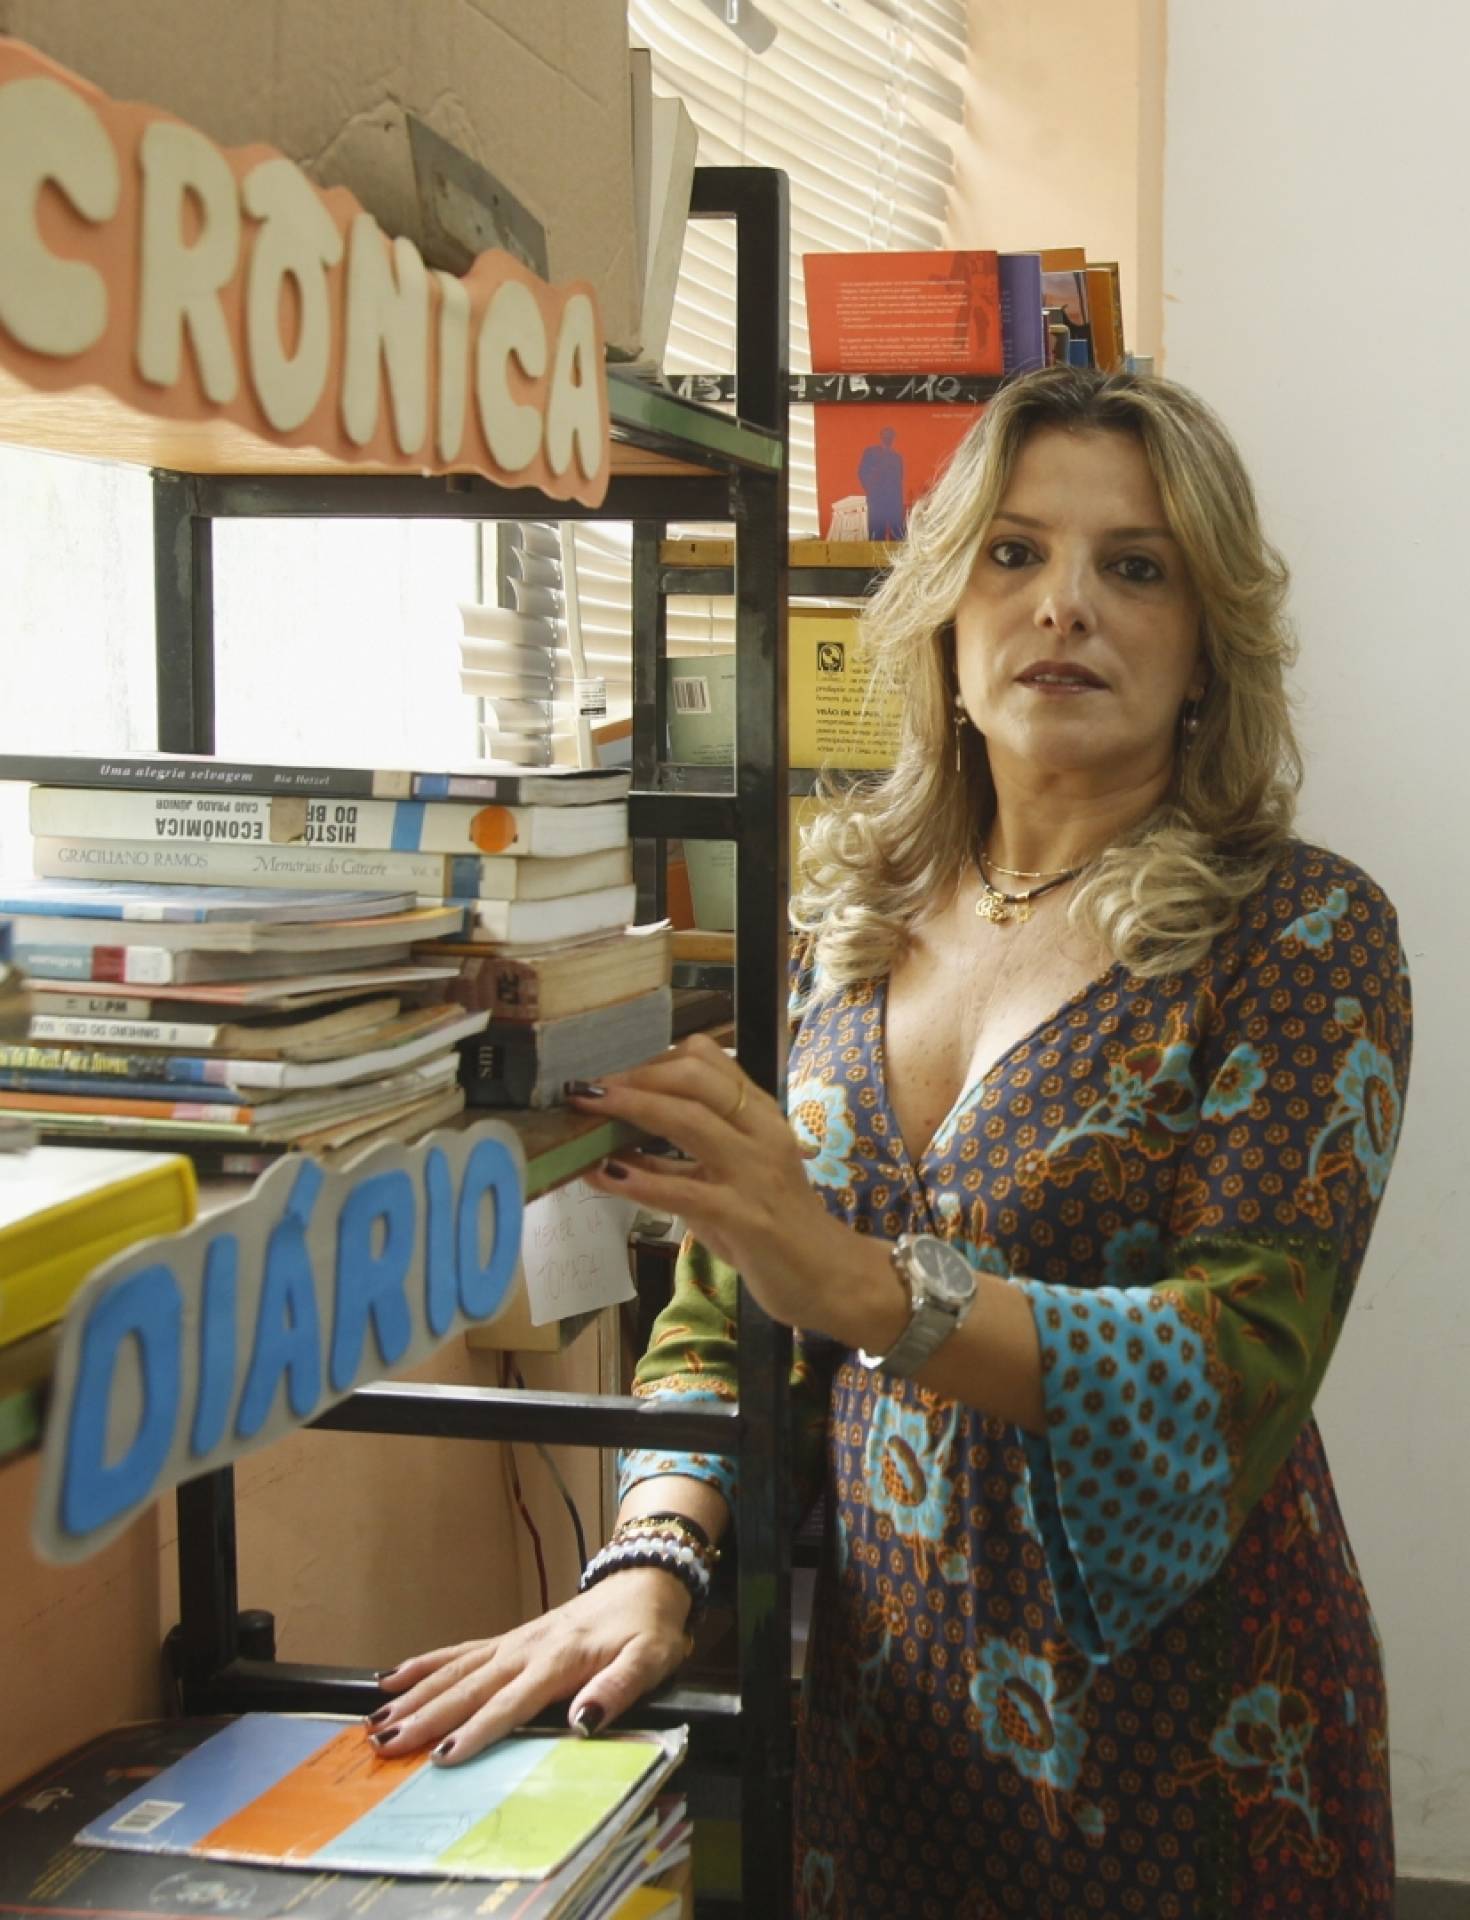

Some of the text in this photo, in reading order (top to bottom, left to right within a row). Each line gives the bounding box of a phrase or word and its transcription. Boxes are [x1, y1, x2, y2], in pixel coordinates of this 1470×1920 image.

[0, 76, 599, 481] CRÔNICA
[99, 764, 131, 777] Uma
[135, 766, 185, 780] alegria
[190, 768, 253, 784] selvagem
[197, 800, 231, 813] PRADO
[235, 802, 259, 814] CAIO
[335, 805, 358, 824] DO
[155, 817, 263, 842] ECONÔMICA
[57, 847, 149, 866] GRACILIANO
[153, 850, 208, 868] RAMOS
[60, 1138, 522, 1535] DIÁRIO
